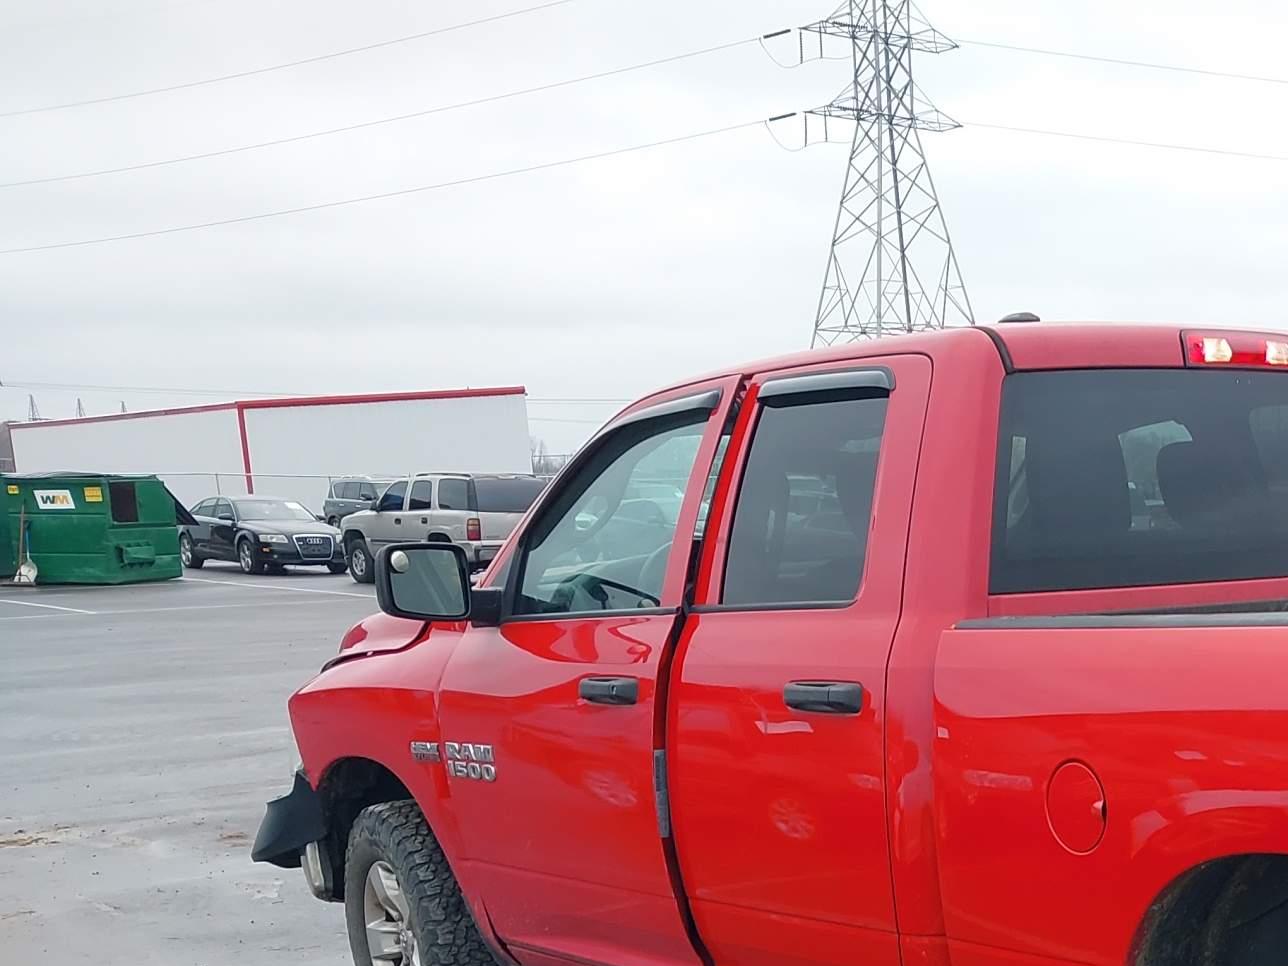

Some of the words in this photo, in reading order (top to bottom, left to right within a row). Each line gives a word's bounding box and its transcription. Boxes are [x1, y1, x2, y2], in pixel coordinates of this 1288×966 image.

[40, 495, 70, 505] WM
[445, 741, 494, 762] RAM
[447, 760, 496, 782] 1500
